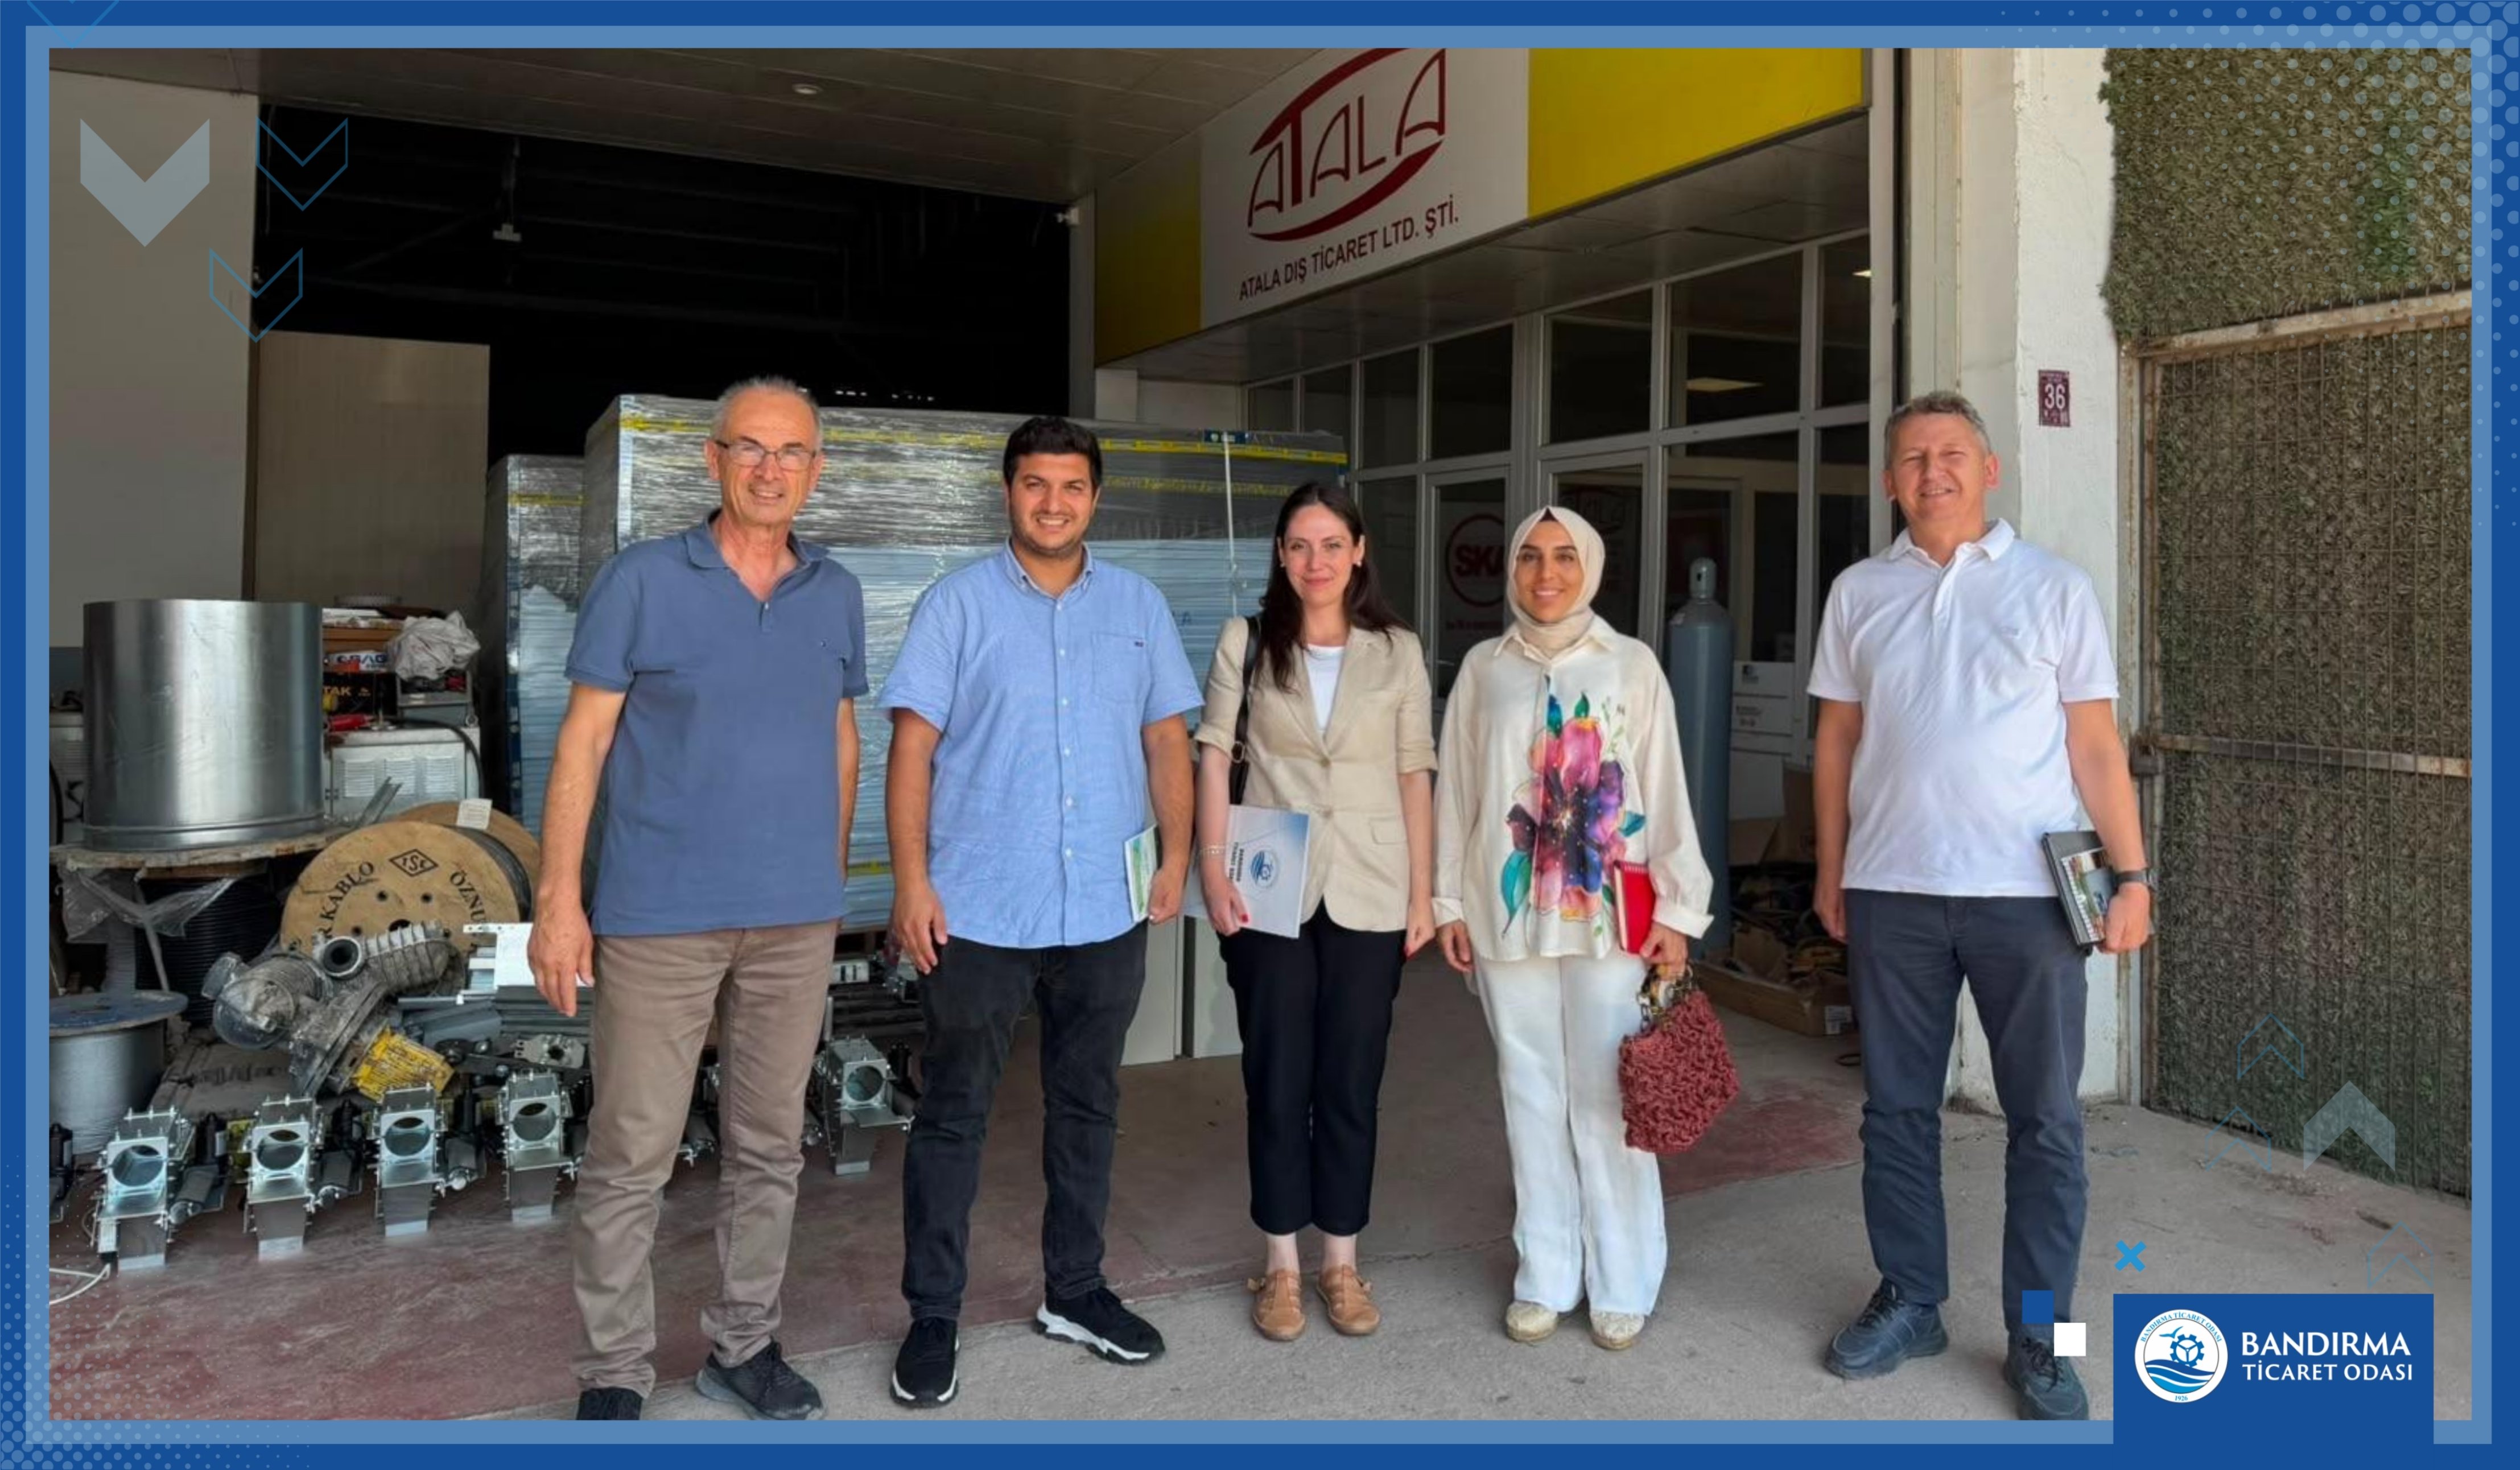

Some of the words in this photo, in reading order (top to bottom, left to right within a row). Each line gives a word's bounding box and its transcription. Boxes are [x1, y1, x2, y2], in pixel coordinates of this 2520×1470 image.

[1248, 48, 1446, 228] ATALA
[1239, 269, 1281, 300] ATALA
[1284, 258, 1308, 283] DIŞ
[1311, 230, 1378, 274] TİCARET
[1383, 217, 1420, 249] LTD.
[1425, 194, 1459, 238] ŞTİ.
[2044, 383, 2065, 409] 36
[320, 861, 374, 921] KABLO
[449, 869, 488, 936] ÖZNU
